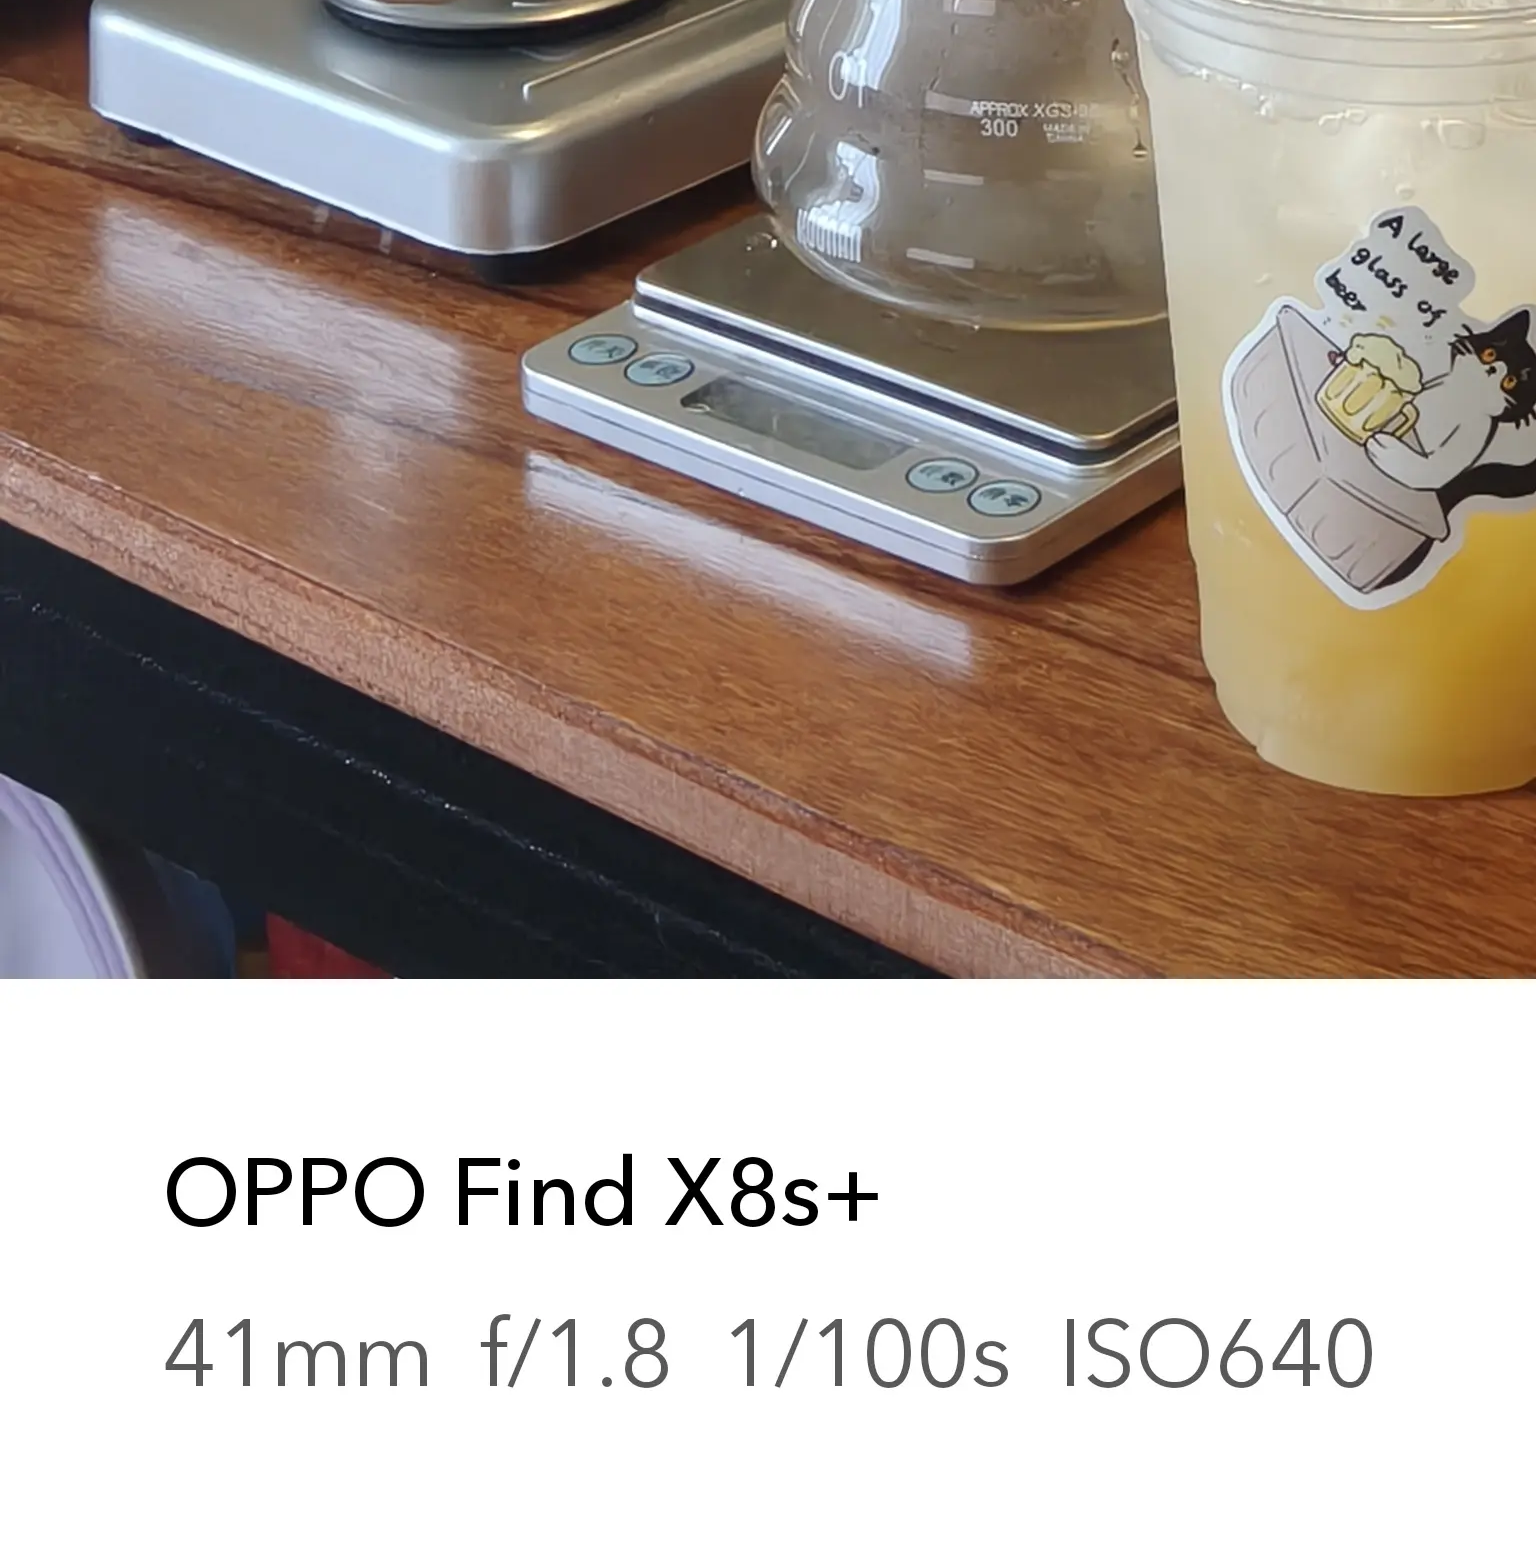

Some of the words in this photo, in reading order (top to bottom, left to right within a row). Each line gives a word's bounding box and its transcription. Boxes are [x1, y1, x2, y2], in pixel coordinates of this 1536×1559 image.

[970, 100, 1028, 117] APPROX
[980, 118, 1018, 137] 300
[1378, 215, 1404, 238] A
[1407, 231, 1460, 285] large
[1325, 268, 1367, 313] beer
[1351, 248, 1408, 298] glass
[1416, 299, 1447, 327] of
